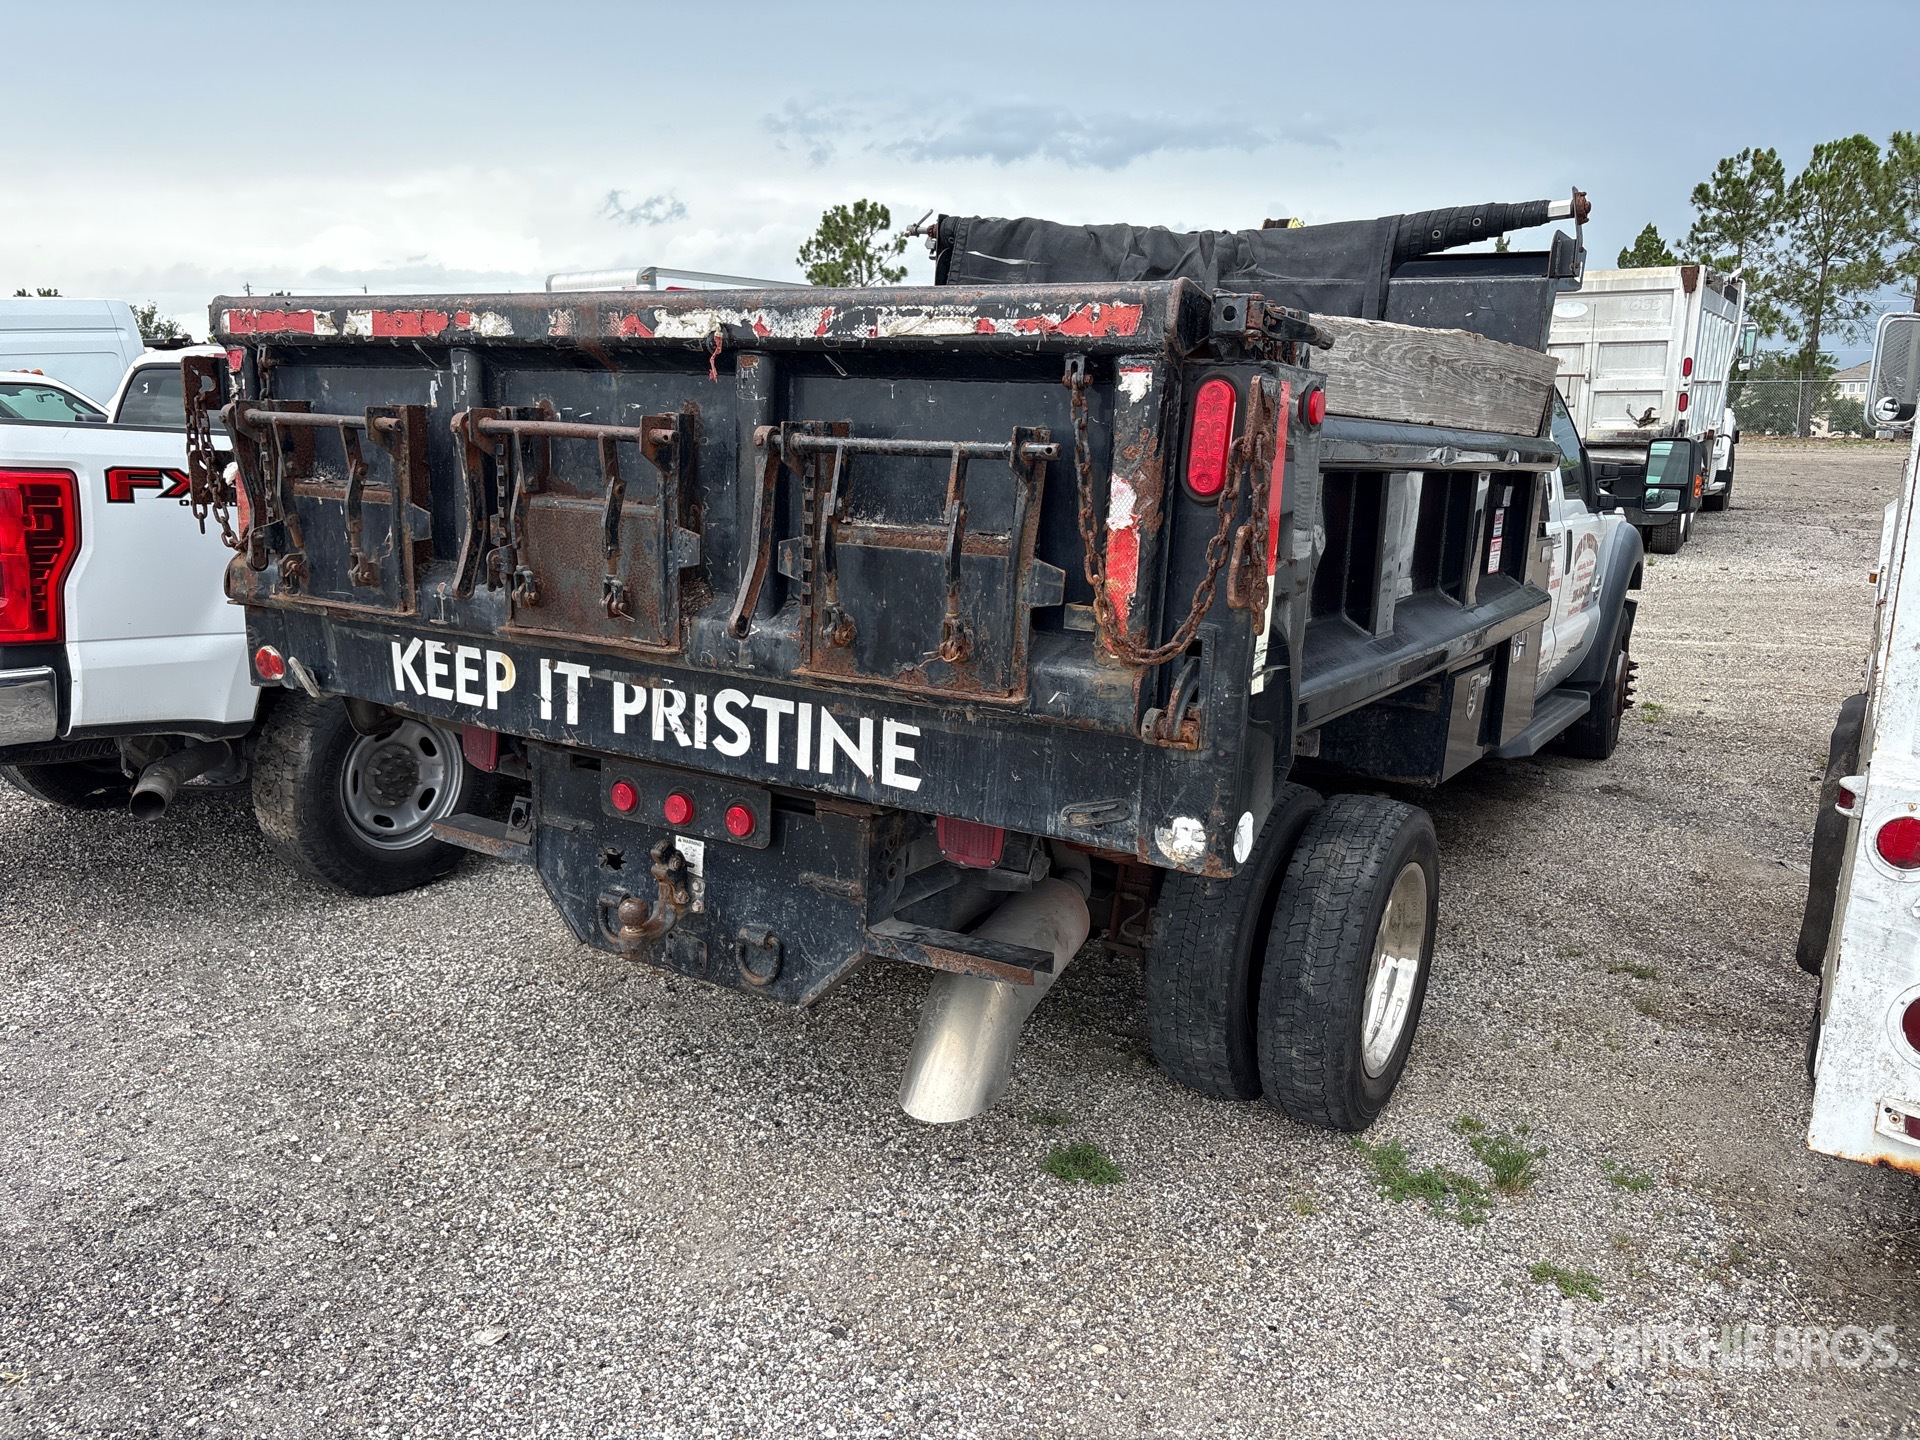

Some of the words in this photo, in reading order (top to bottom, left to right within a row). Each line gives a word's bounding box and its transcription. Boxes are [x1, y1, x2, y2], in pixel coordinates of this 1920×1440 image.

[391, 637, 516, 710] KEEP
[540, 658, 590, 725] IT
[613, 680, 921, 792] PRISTINE
